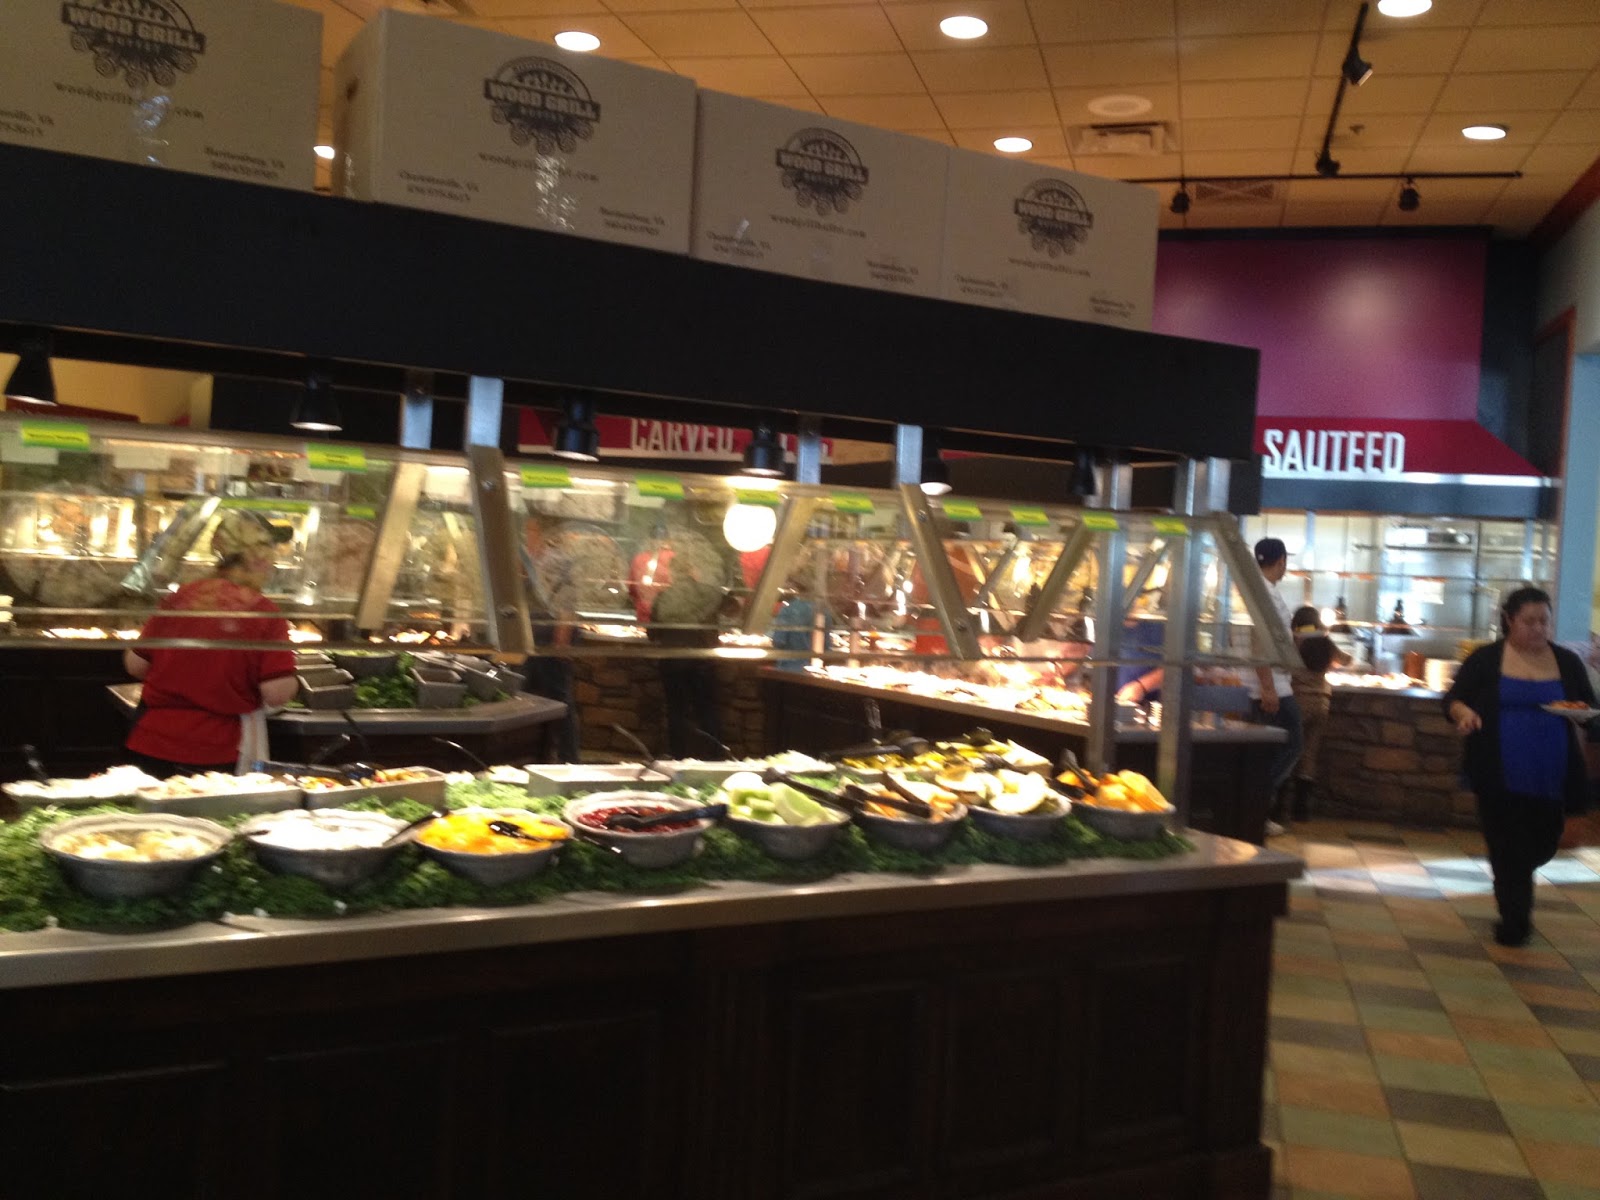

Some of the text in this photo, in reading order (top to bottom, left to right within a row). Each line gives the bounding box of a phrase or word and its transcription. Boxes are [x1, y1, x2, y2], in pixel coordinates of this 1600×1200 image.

[67, 6, 134, 36] WOOD
[136, 22, 202, 52] GRILL
[489, 80, 543, 107] WOOD
[545, 94, 597, 120] GRILL
[630, 416, 734, 453] CARVED
[1263, 428, 1406, 473] SAUTEED
